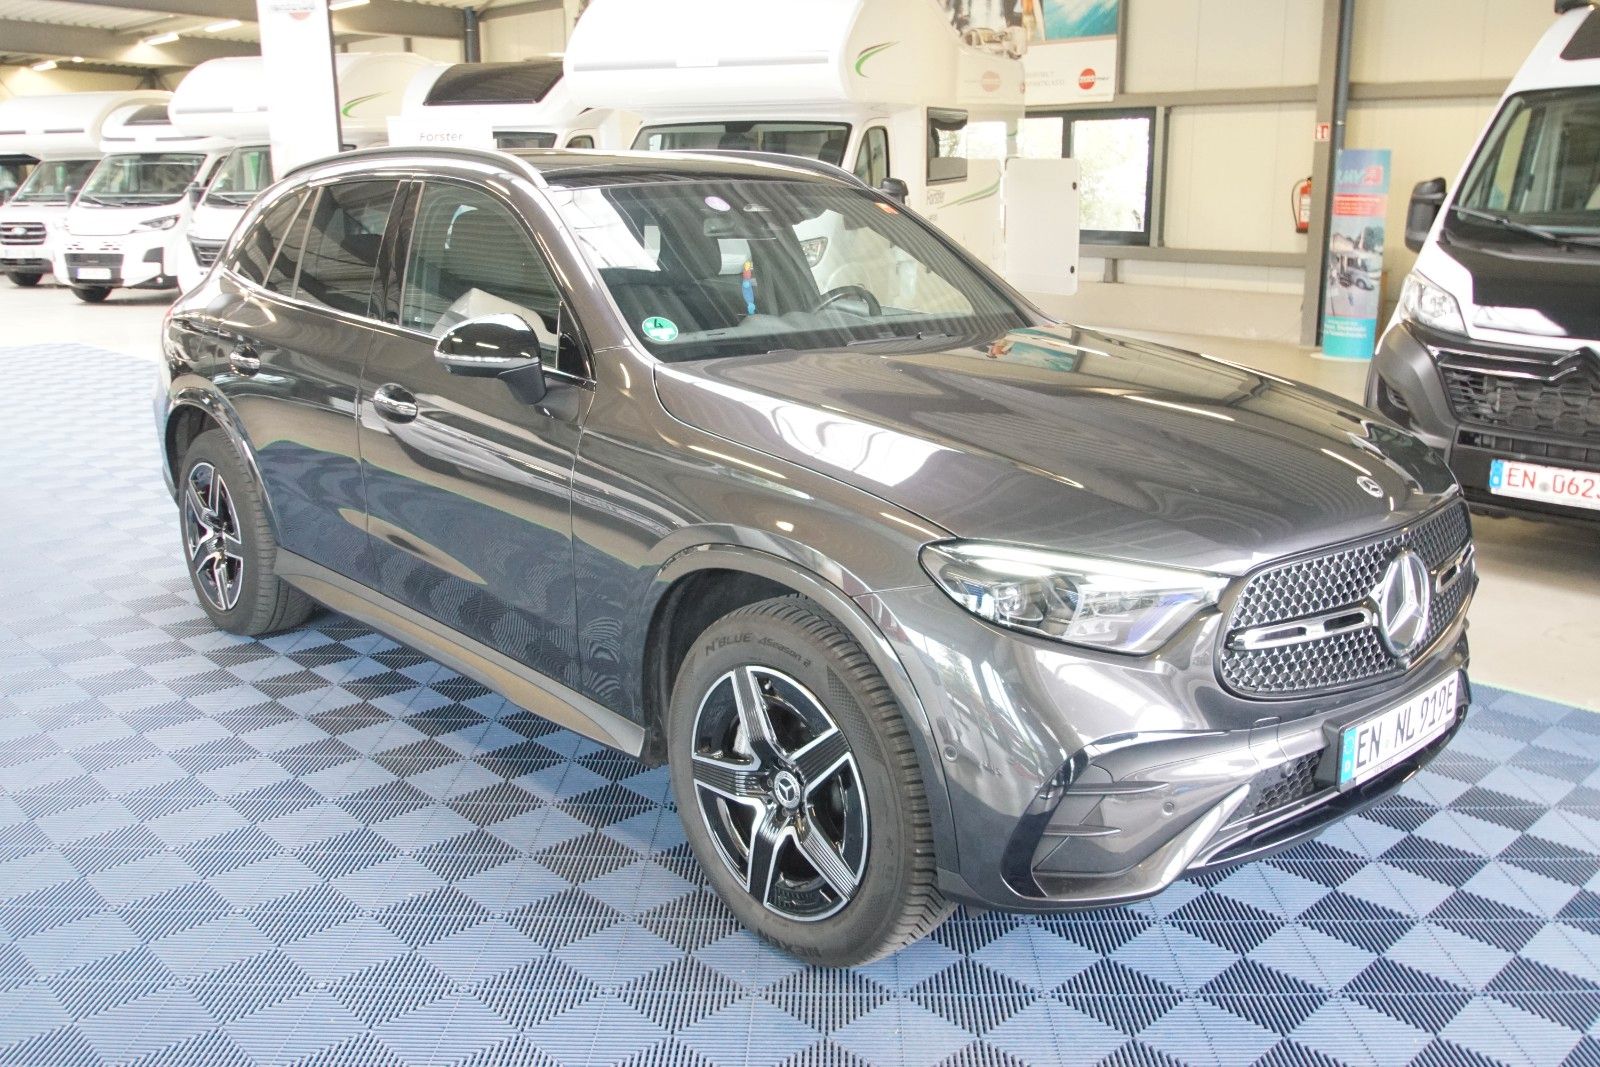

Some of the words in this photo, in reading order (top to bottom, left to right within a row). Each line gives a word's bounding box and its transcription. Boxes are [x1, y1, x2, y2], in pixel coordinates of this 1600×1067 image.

[654, 318, 664, 328] 4
[1507, 467, 1537, 490] EN
[1356, 721, 1383, 769] EN
[1394, 705, 1415, 748] NL
[1420, 679, 1455, 733] 919E
